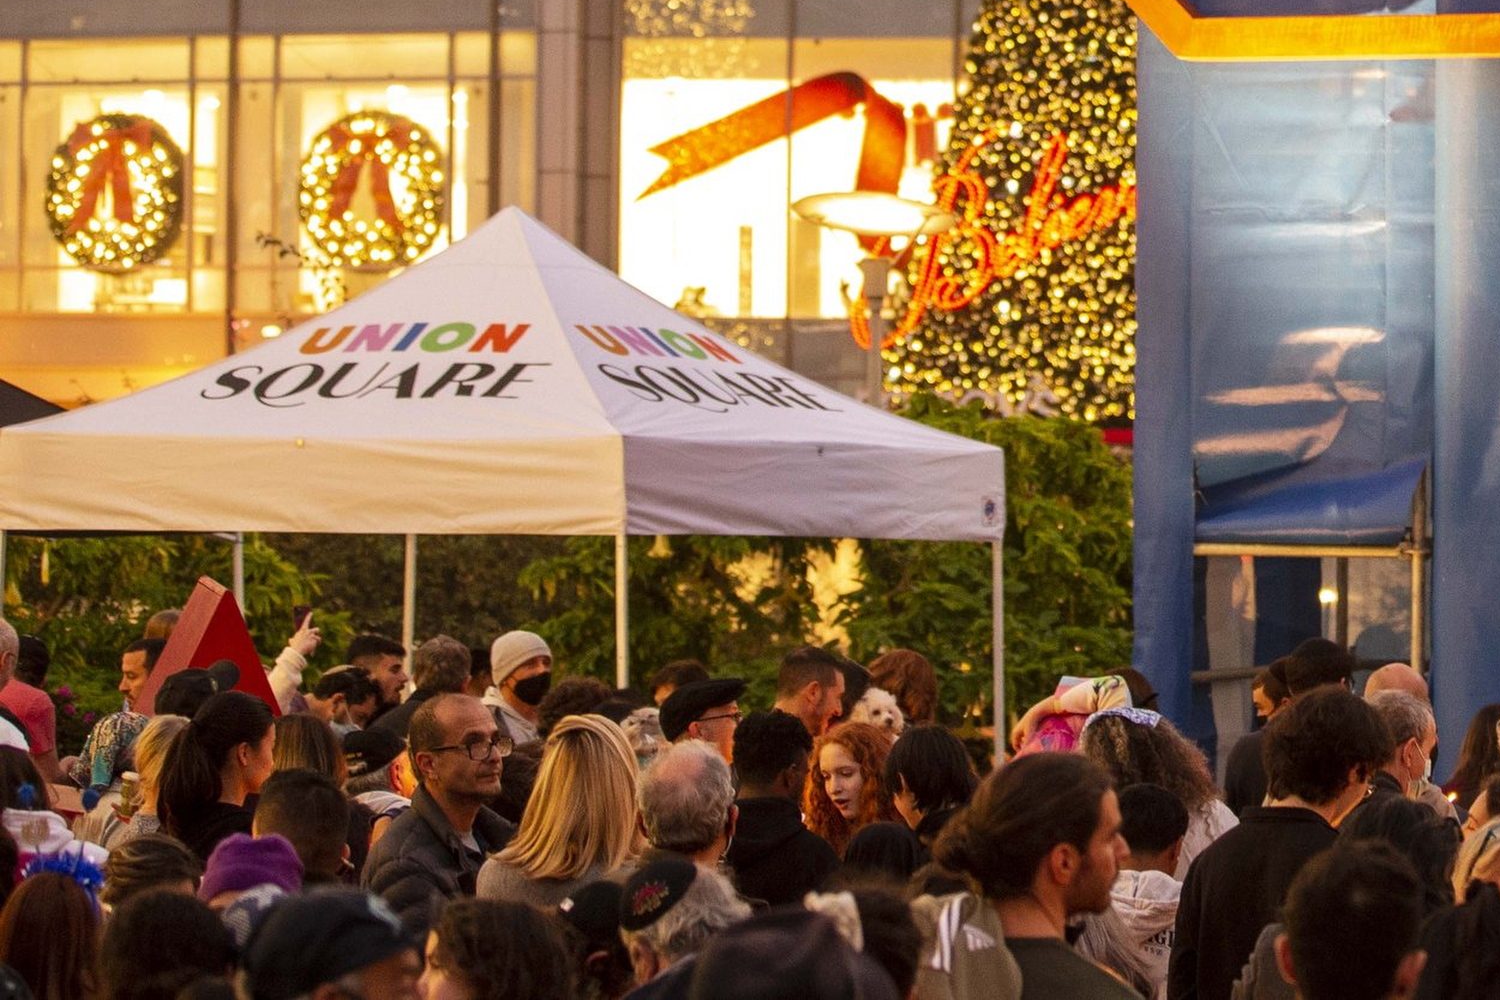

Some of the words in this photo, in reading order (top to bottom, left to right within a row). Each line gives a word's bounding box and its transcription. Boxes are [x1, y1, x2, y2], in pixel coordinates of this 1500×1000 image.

[298, 321, 532, 355] UNION
[574, 324, 744, 365] UNION
[200, 361, 553, 408] SQUARE
[597, 363, 844, 413] SQUARE
